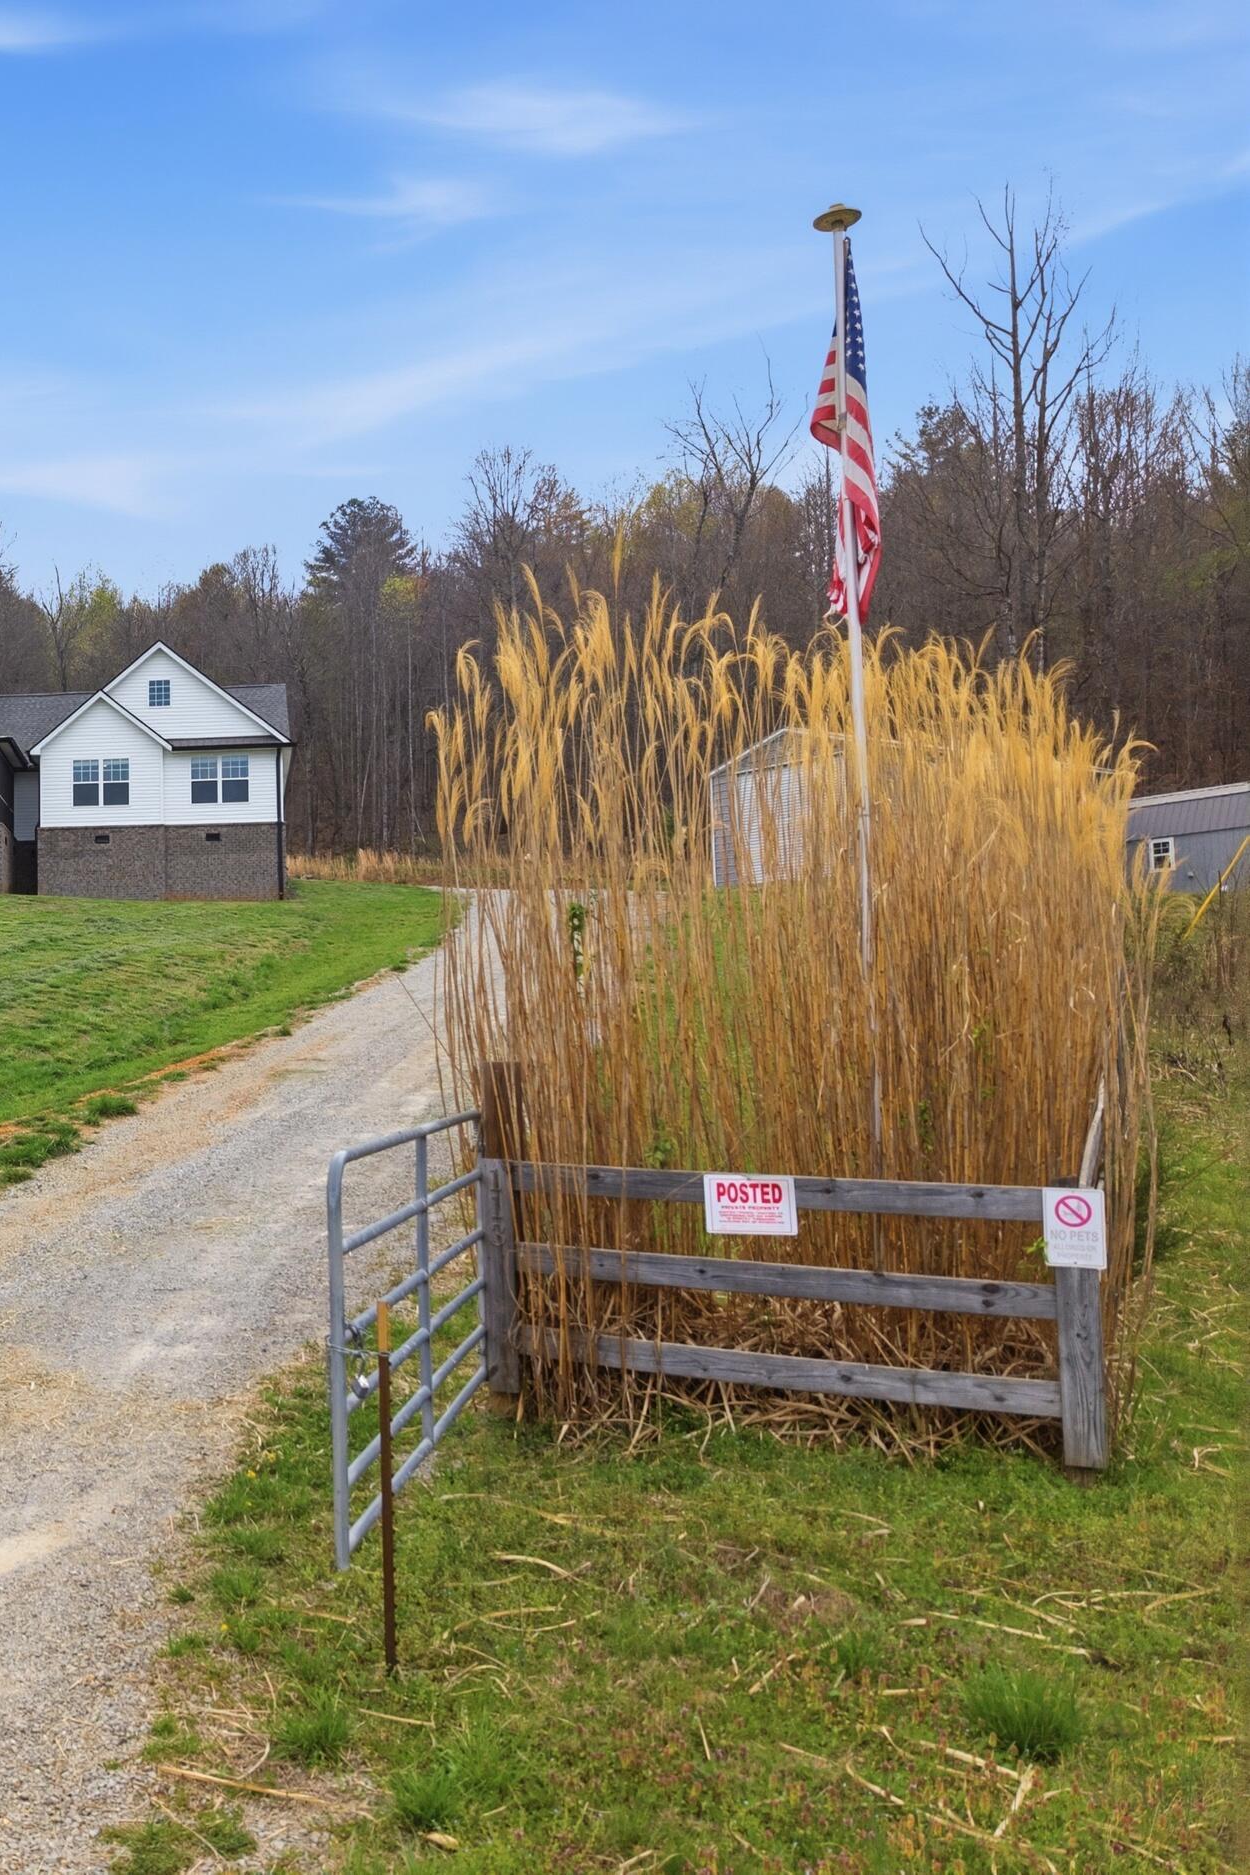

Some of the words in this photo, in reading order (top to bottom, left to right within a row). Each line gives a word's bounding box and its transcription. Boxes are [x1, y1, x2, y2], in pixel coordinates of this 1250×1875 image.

[716, 1182, 783, 1204] POSTED
[1050, 1229, 1067, 1241] NO
[1070, 1230, 1100, 1242] PETS
